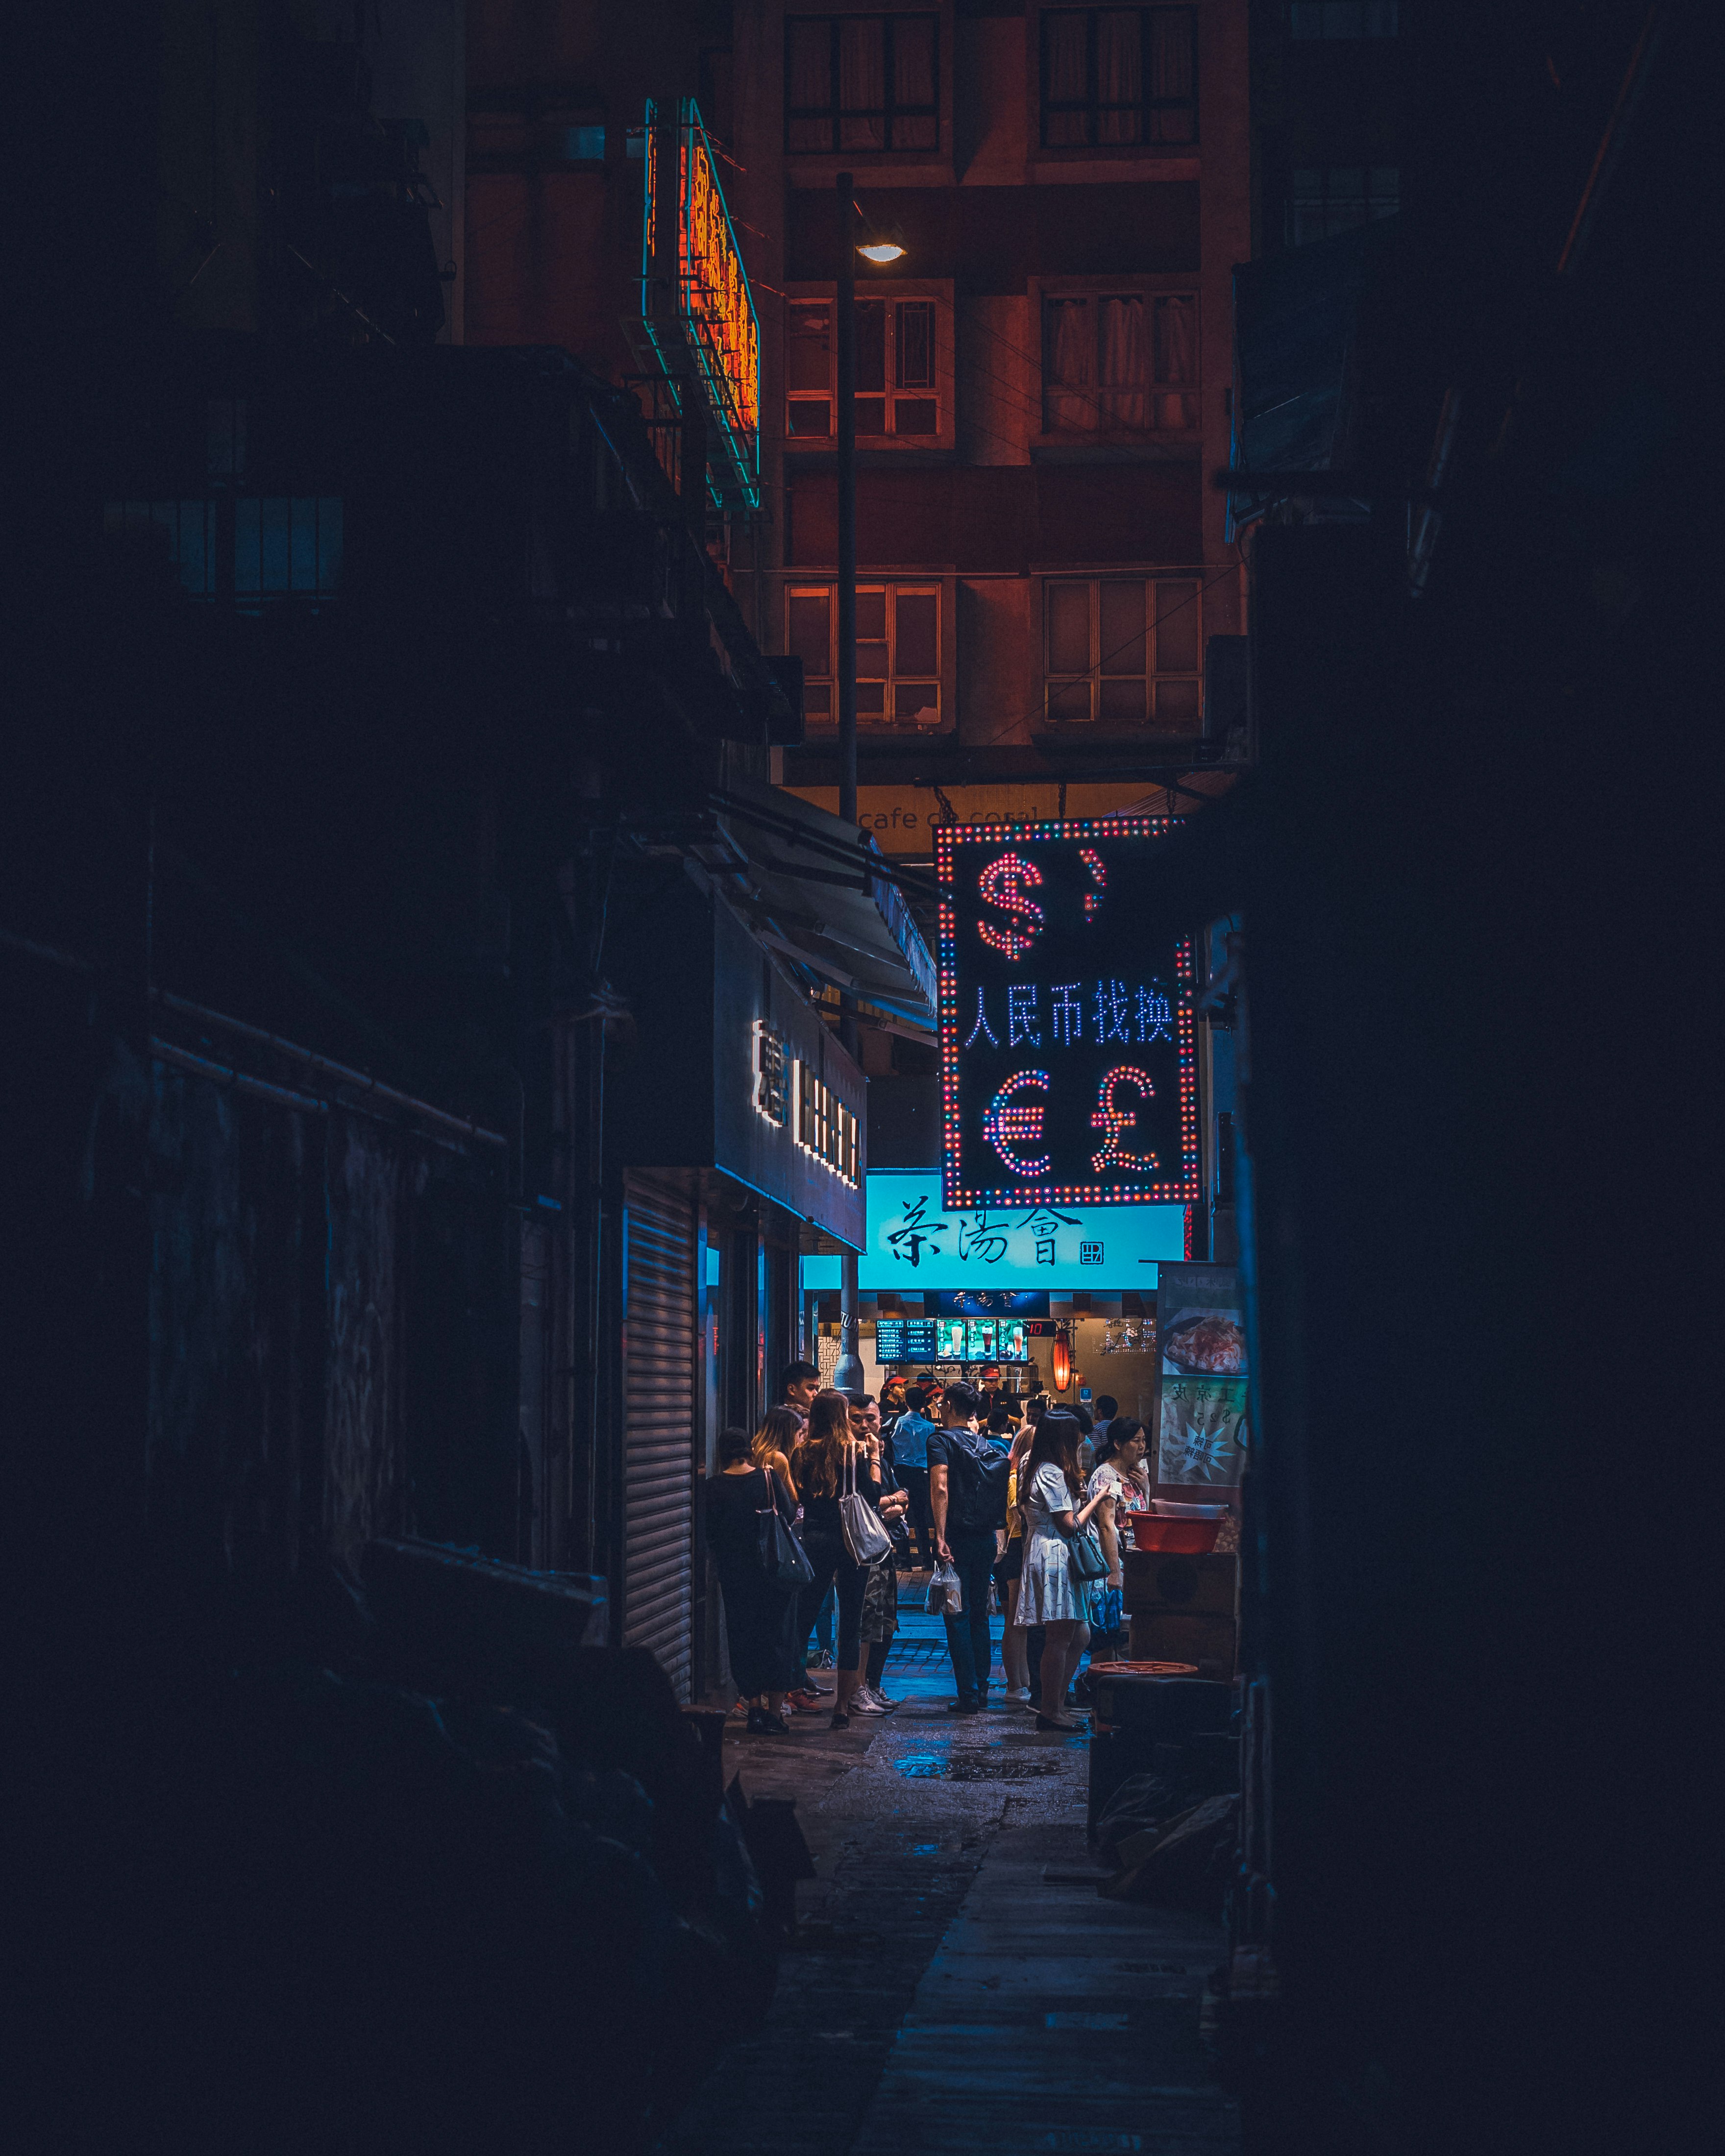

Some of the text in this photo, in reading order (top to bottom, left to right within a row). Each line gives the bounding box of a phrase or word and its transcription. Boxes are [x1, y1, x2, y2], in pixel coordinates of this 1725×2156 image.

[858, 808, 917, 830] cafe
[982, 1068, 1051, 1177] €
[1091, 1065, 1160, 1173] £
[887, 1195, 1084, 1268] 茶湯會
[1030, 1323, 1043, 1335] 10
